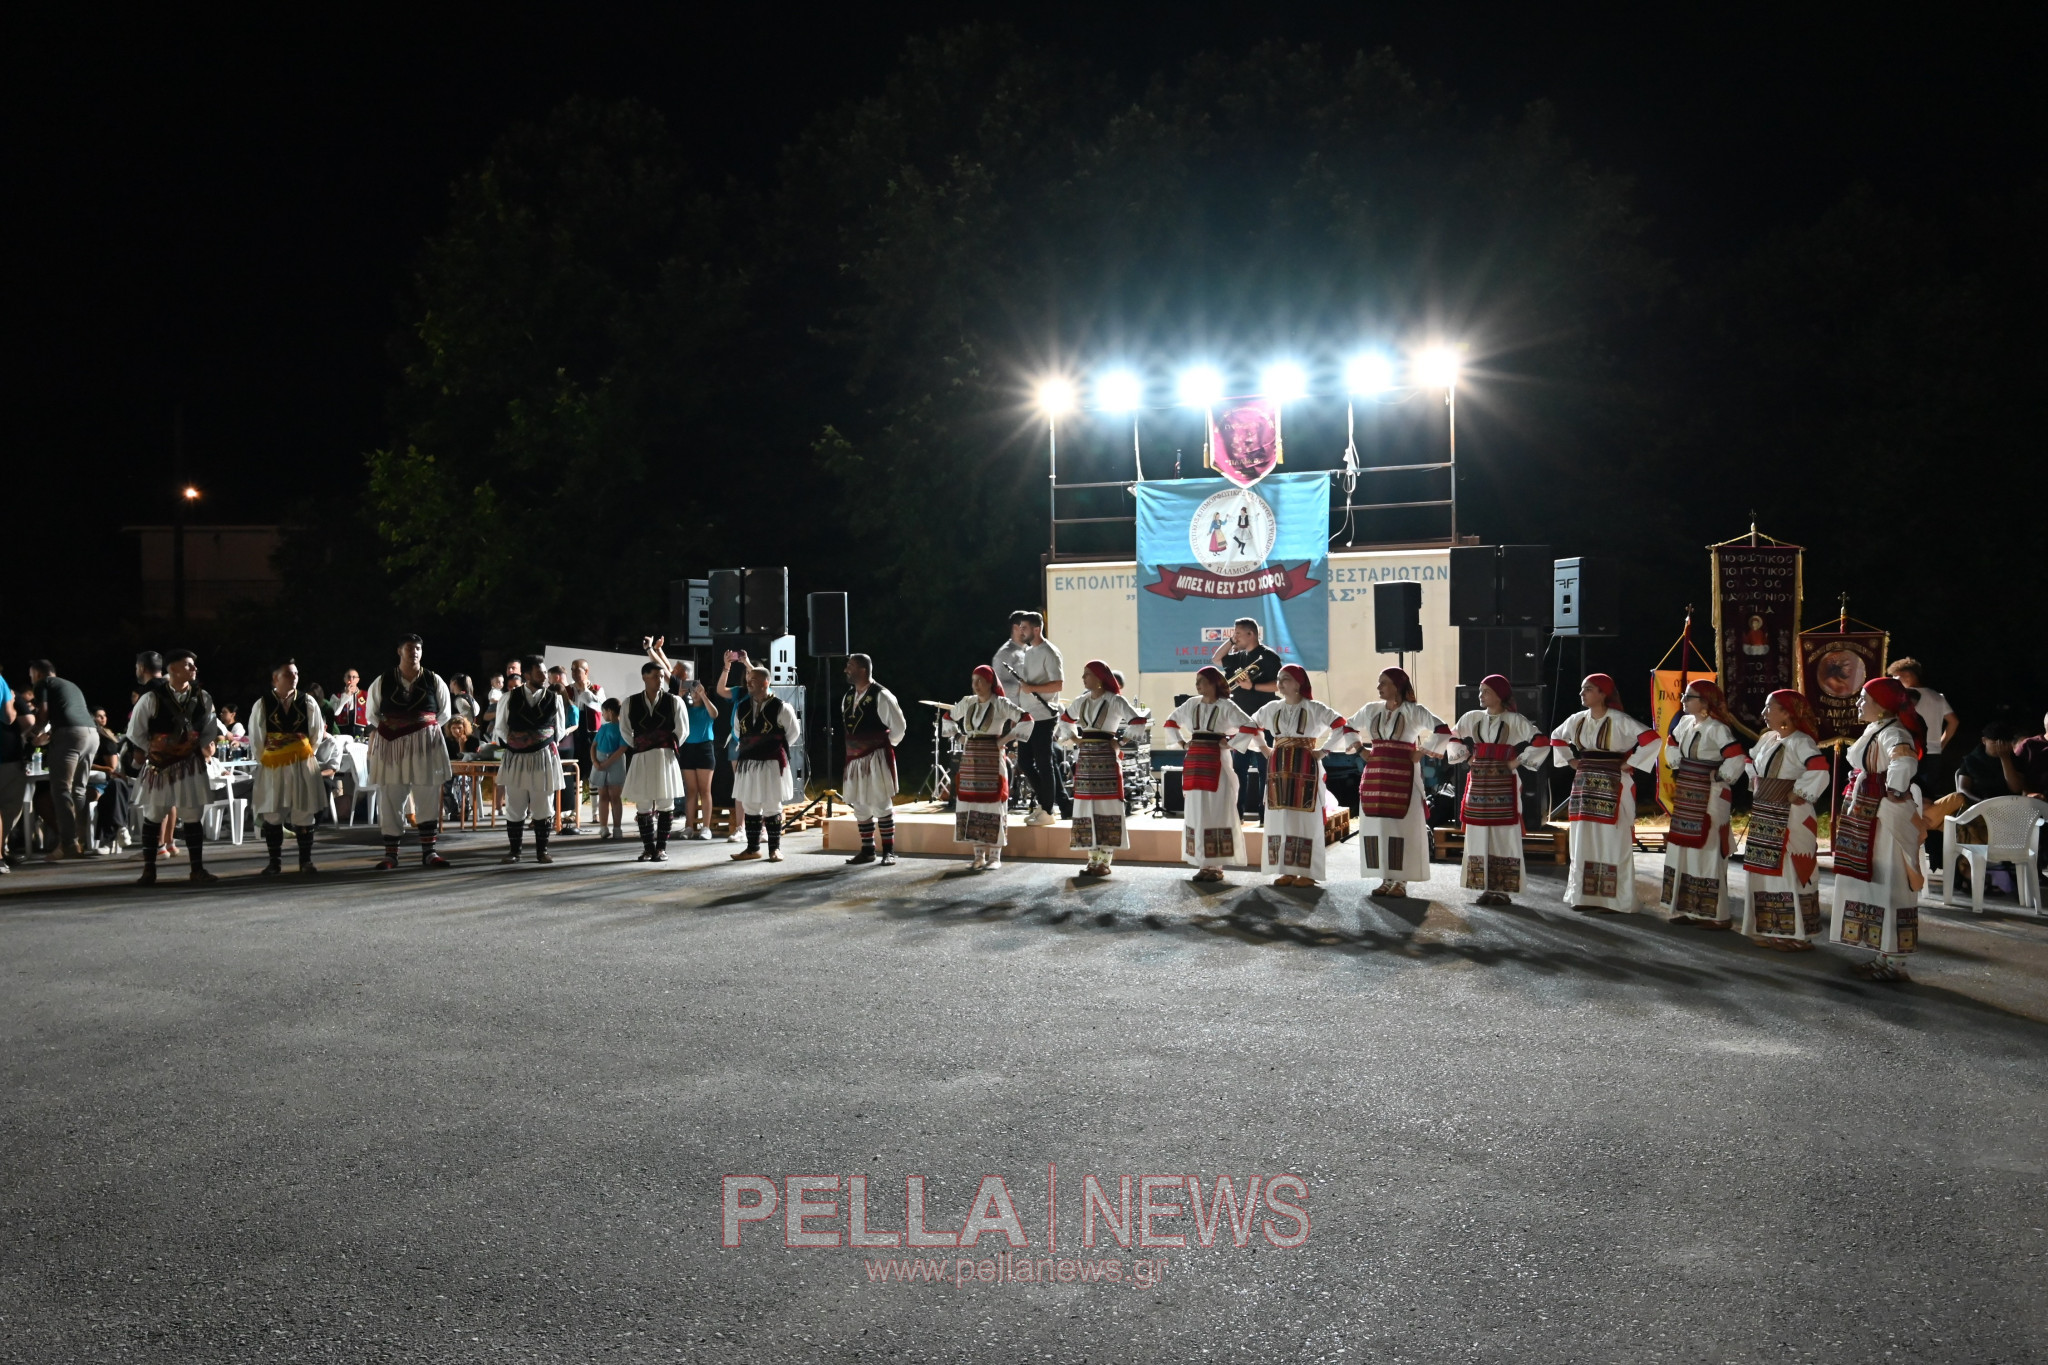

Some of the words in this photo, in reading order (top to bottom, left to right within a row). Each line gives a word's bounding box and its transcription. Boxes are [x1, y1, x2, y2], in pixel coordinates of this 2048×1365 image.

[1055, 574, 1137, 591] ΕΚΠΟΛΙΤΙΣ
[1176, 575, 1204, 592] ΜΠΕΣ
[1204, 580, 1215, 594] ΚΙ
[1216, 581, 1236, 594] ΕΣΥ
[1236, 578, 1256, 593] ΣΤΟ
[1257, 572, 1286, 590] ΧΟΡΟ!
